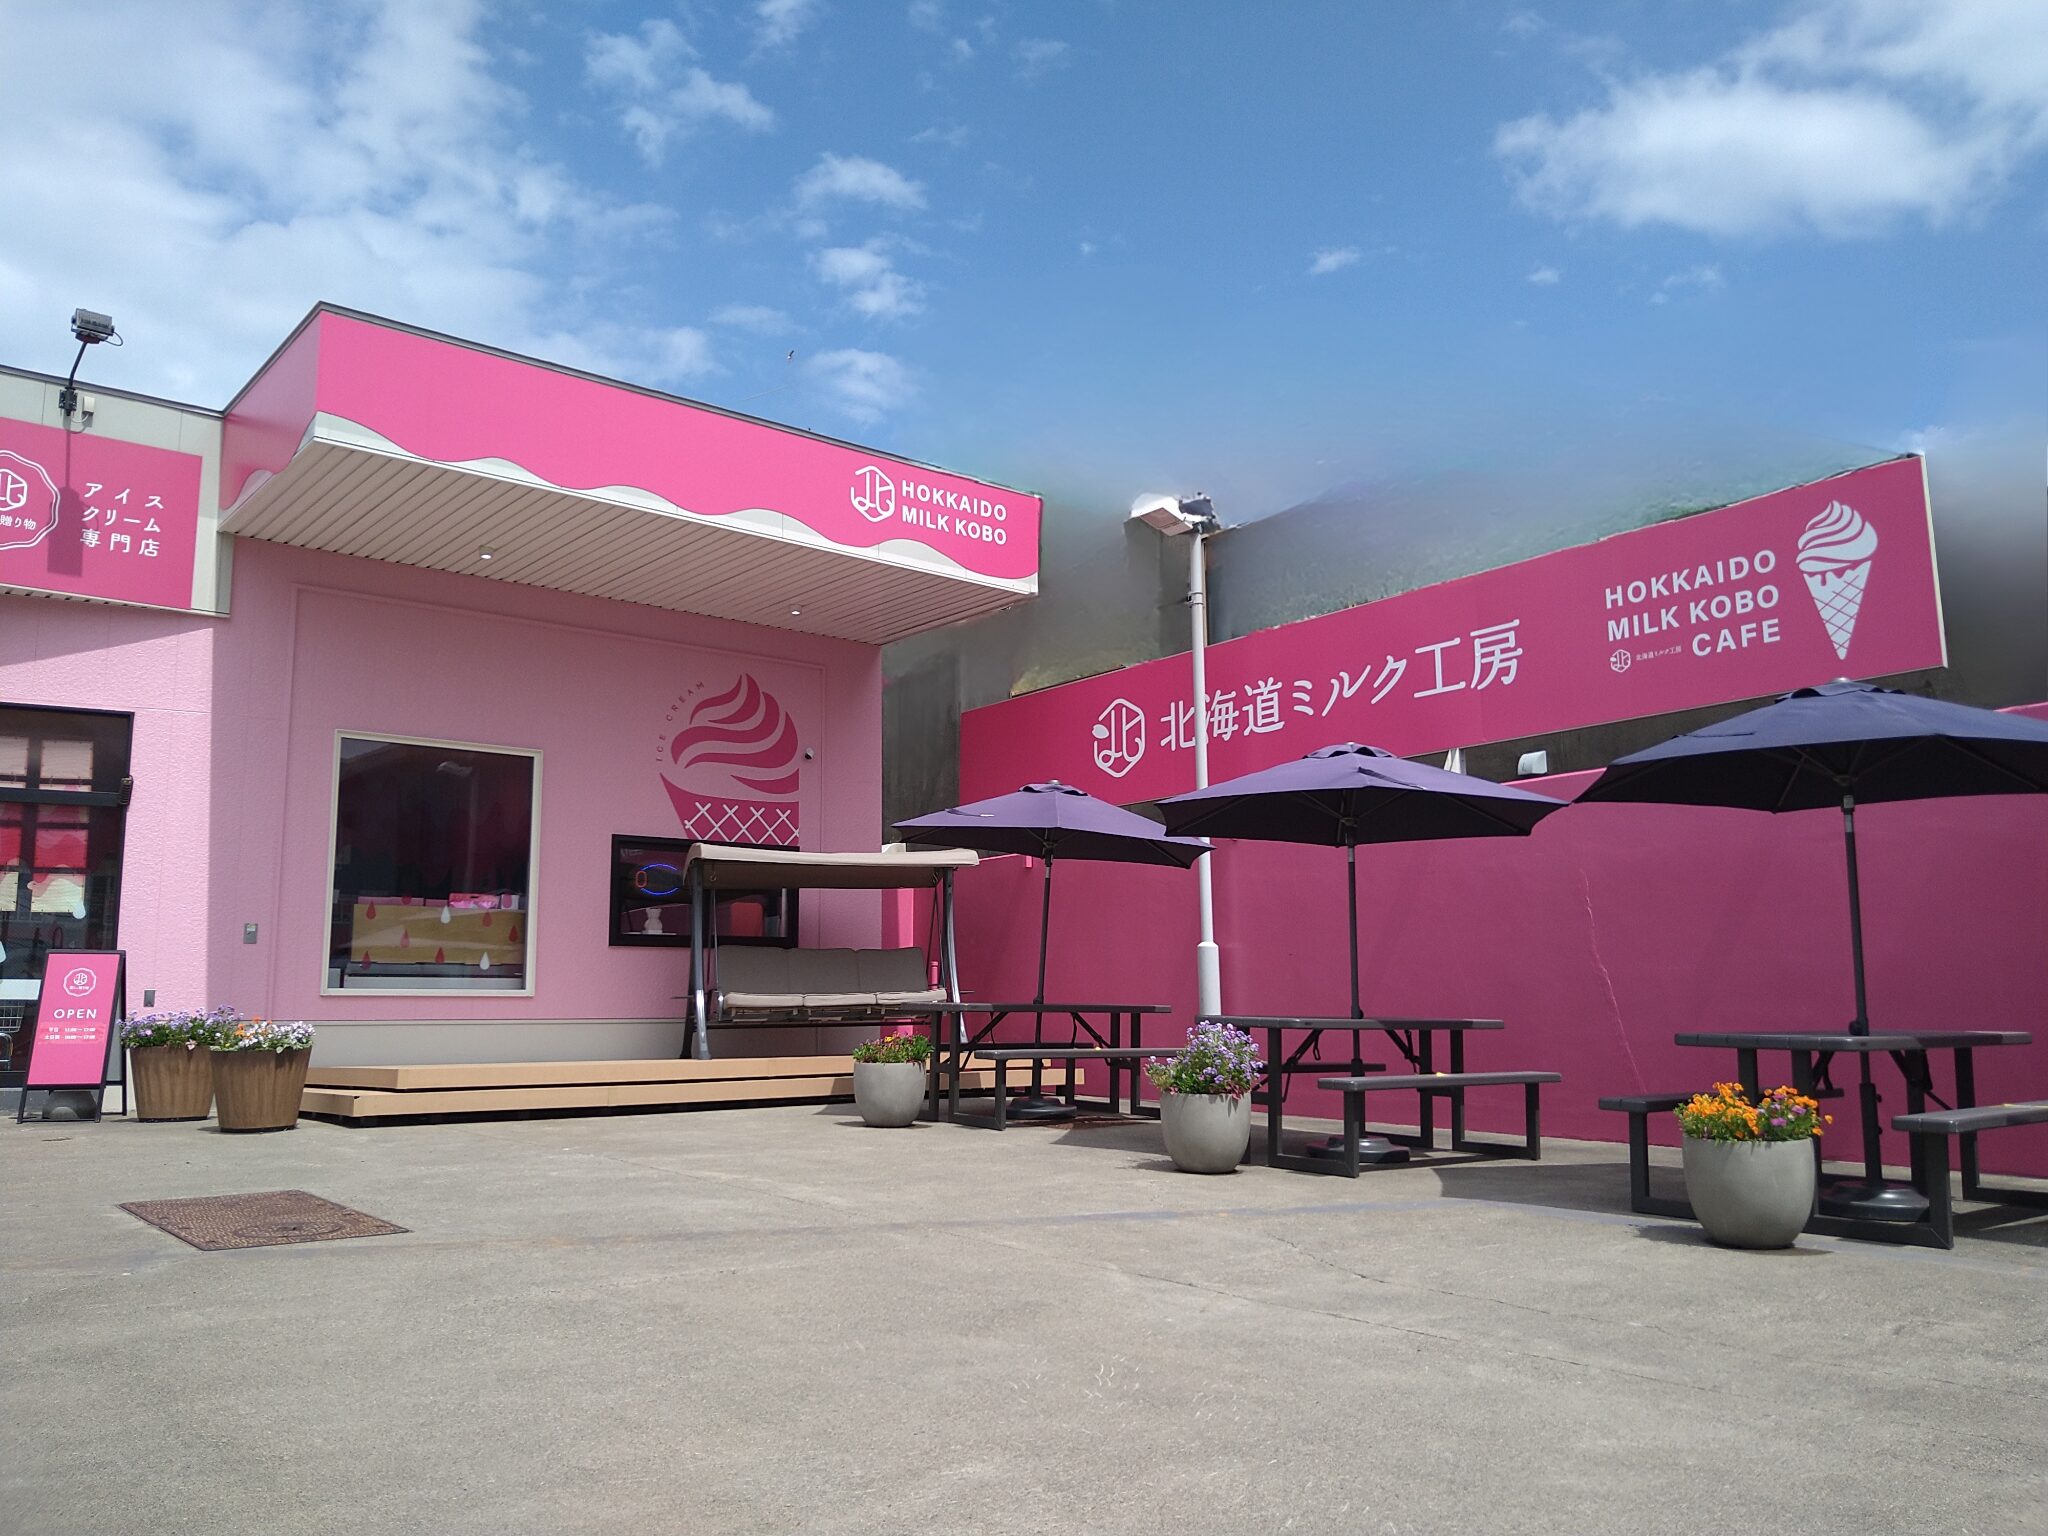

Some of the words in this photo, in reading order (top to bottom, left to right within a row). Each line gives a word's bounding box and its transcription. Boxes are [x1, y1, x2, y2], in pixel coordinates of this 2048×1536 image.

[84, 482, 164, 509] アイス
[902, 480, 1007, 521] HOKKAIDO
[82, 506, 161, 533] クリーム
[902, 505, 950, 532] MILK
[955, 518, 1007, 545] KOBO
[80, 528, 161, 557] 専門店
[1605, 550, 1776, 609] HOKKAIDO
[1607, 605, 1680, 642] MILK
[1689, 584, 1779, 624] KOBO
[1692, 618, 1781, 656] CAFE
[1160, 618, 1523, 751] 北海道ミルク工房
[656, 735, 666, 762] ICE
[666, 681, 704, 722] CREAM
[53, 1008, 97, 1019] OPEN
